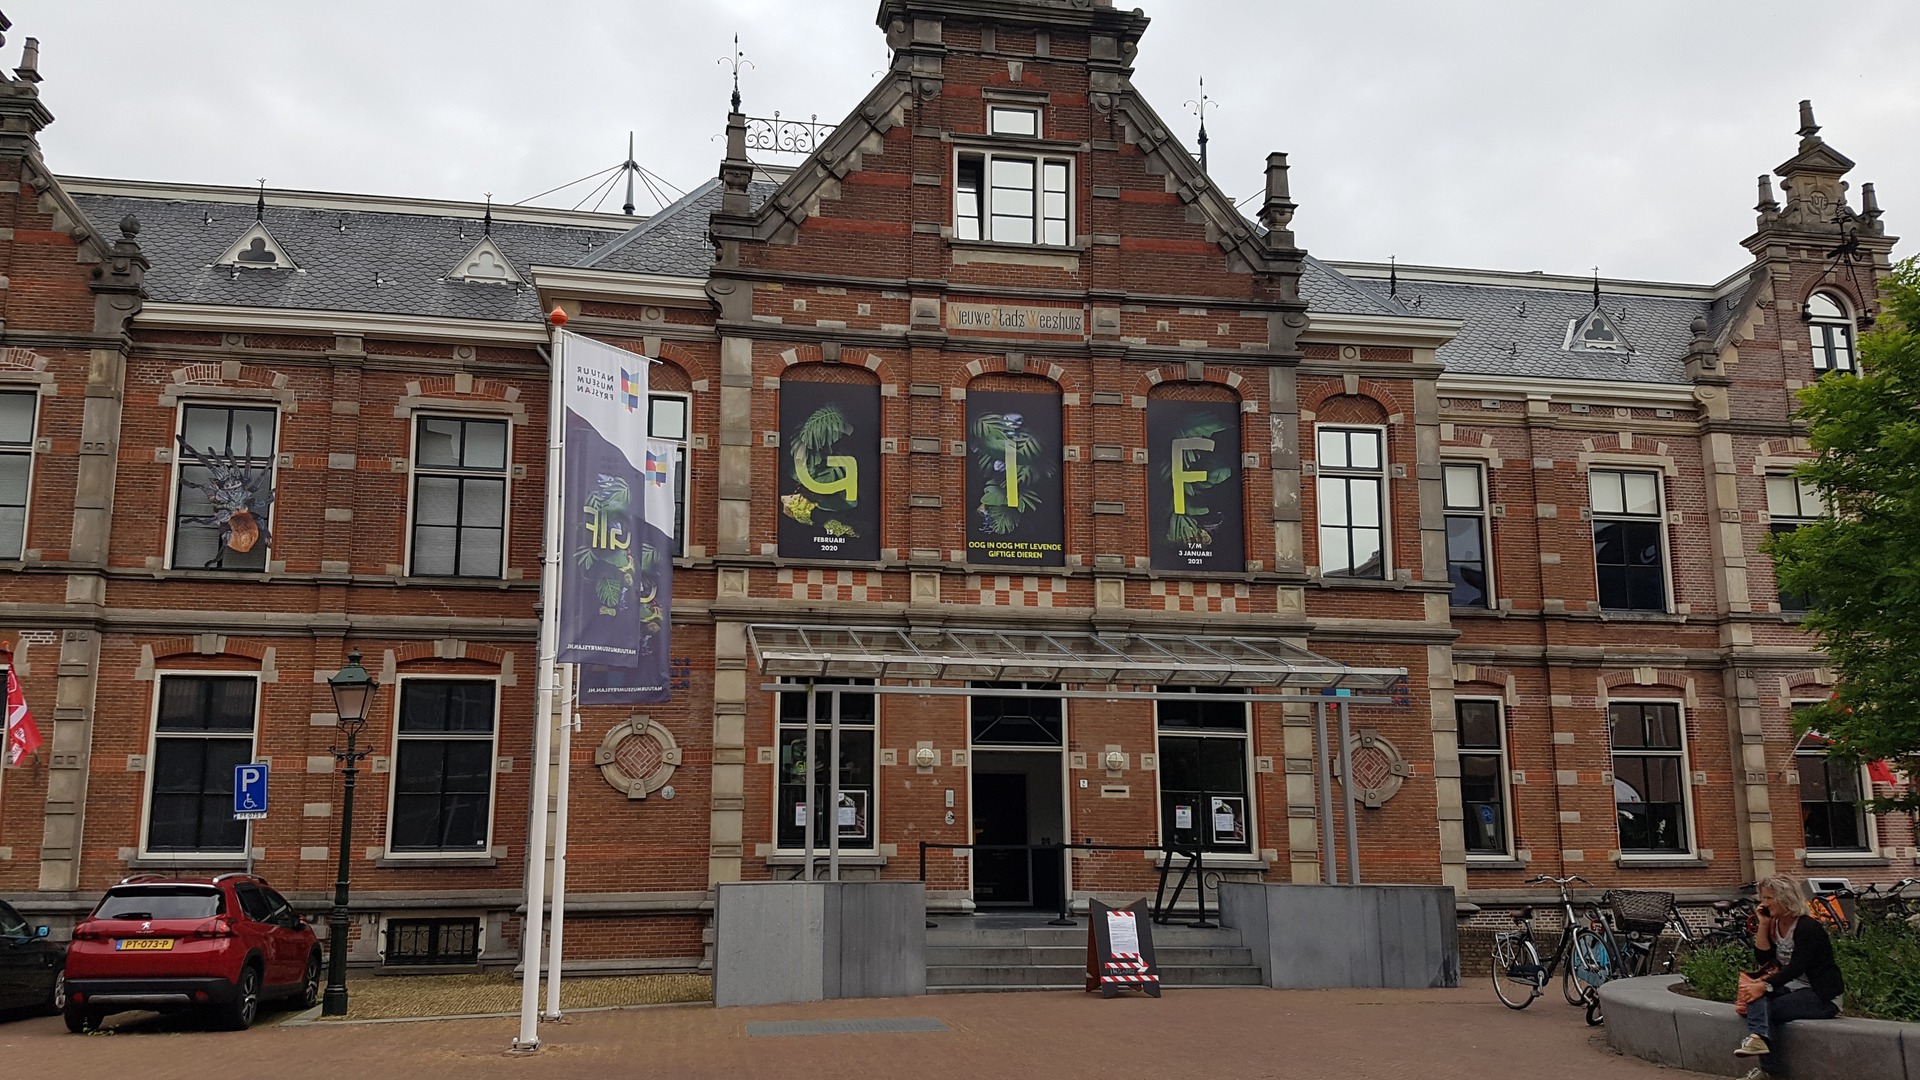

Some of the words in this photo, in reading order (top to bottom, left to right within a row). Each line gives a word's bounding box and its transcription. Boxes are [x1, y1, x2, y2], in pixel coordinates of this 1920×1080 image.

[951, 306, 990, 326] Nieuwe
[991, 308, 1026, 329] Stads
[1026, 309, 1082, 331] Weeshuis
[1171, 437, 1216, 515] F
[968, 541, 986, 549] OOG
[1014, 542, 1028, 550] MET
[988, 550, 1015, 558] GIFTIGE
[1016, 551, 1043, 559] DIEREN
[242, 769, 260, 792] P
[125, 940, 169, 948] PT-073-P
